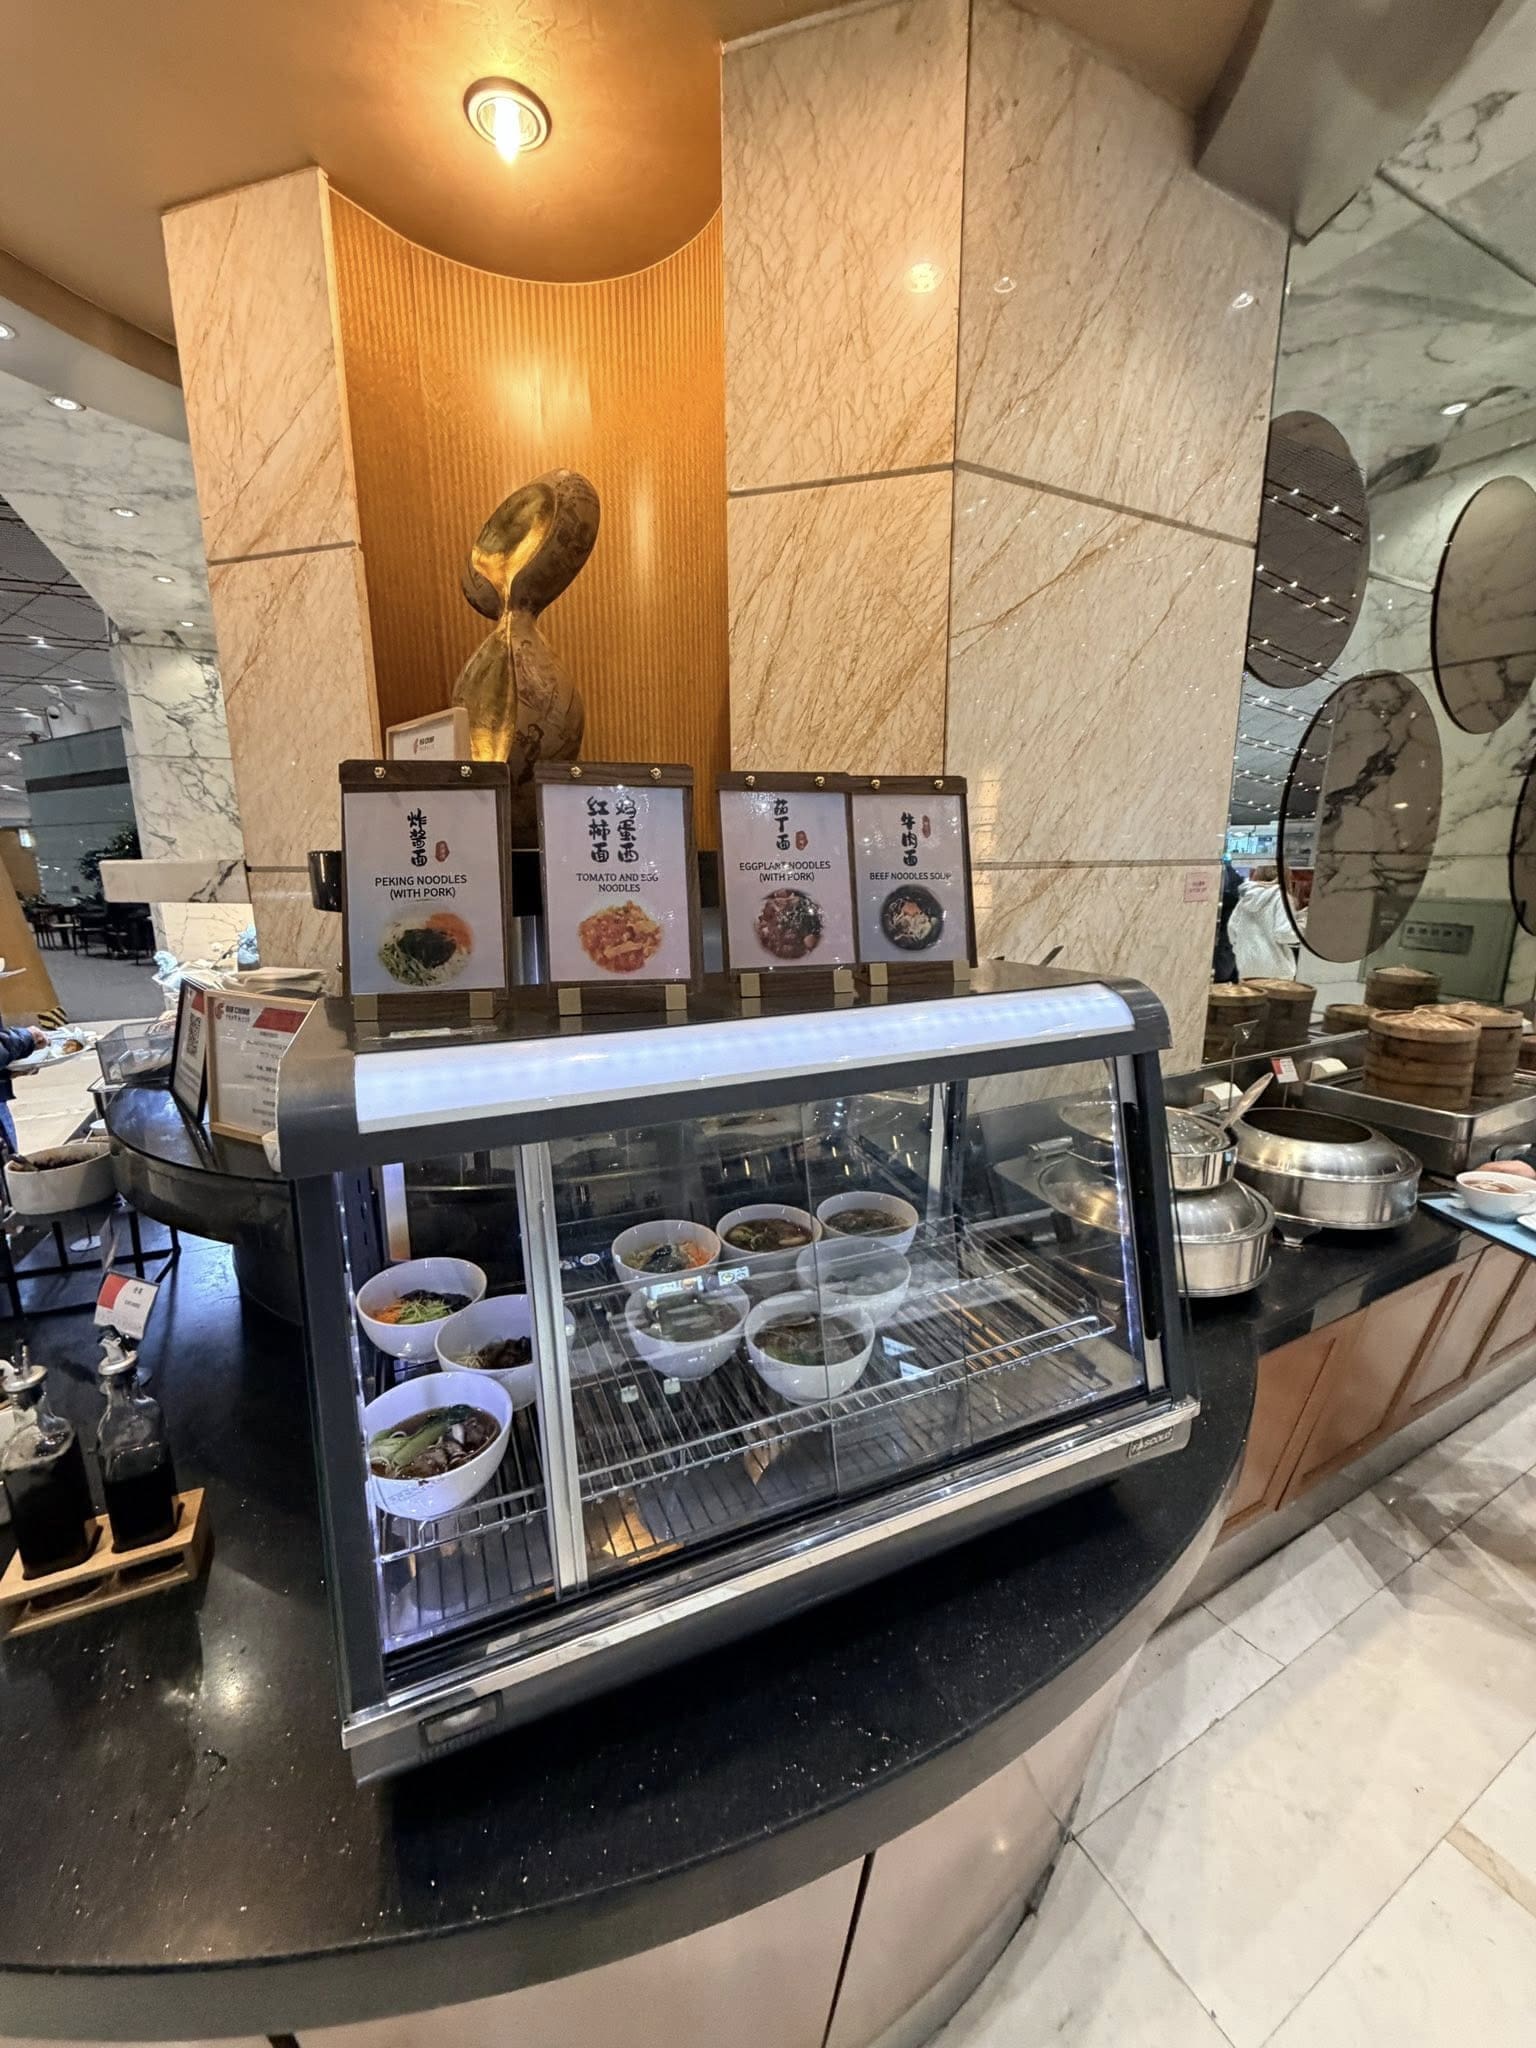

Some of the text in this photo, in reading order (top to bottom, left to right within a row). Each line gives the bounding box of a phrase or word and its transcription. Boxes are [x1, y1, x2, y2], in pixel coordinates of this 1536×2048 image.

[774, 798, 791, 851] 茄丁面
[901, 812, 918, 867] 牛肉面
[739, 861, 831, 871] EGGPLANT NOODLES
[375, 874, 467, 887] PEKING NOODLES
[576, 873, 617, 881] TOMATO
[620, 873, 639, 881] AND
[759, 872, 815, 883] (WITH PORK)
[869, 872, 951, 880] BEEF NOODLES SOUP
[390, 886, 456, 900] (WITH PORK)
[598, 883, 641, 892] NOODLES
